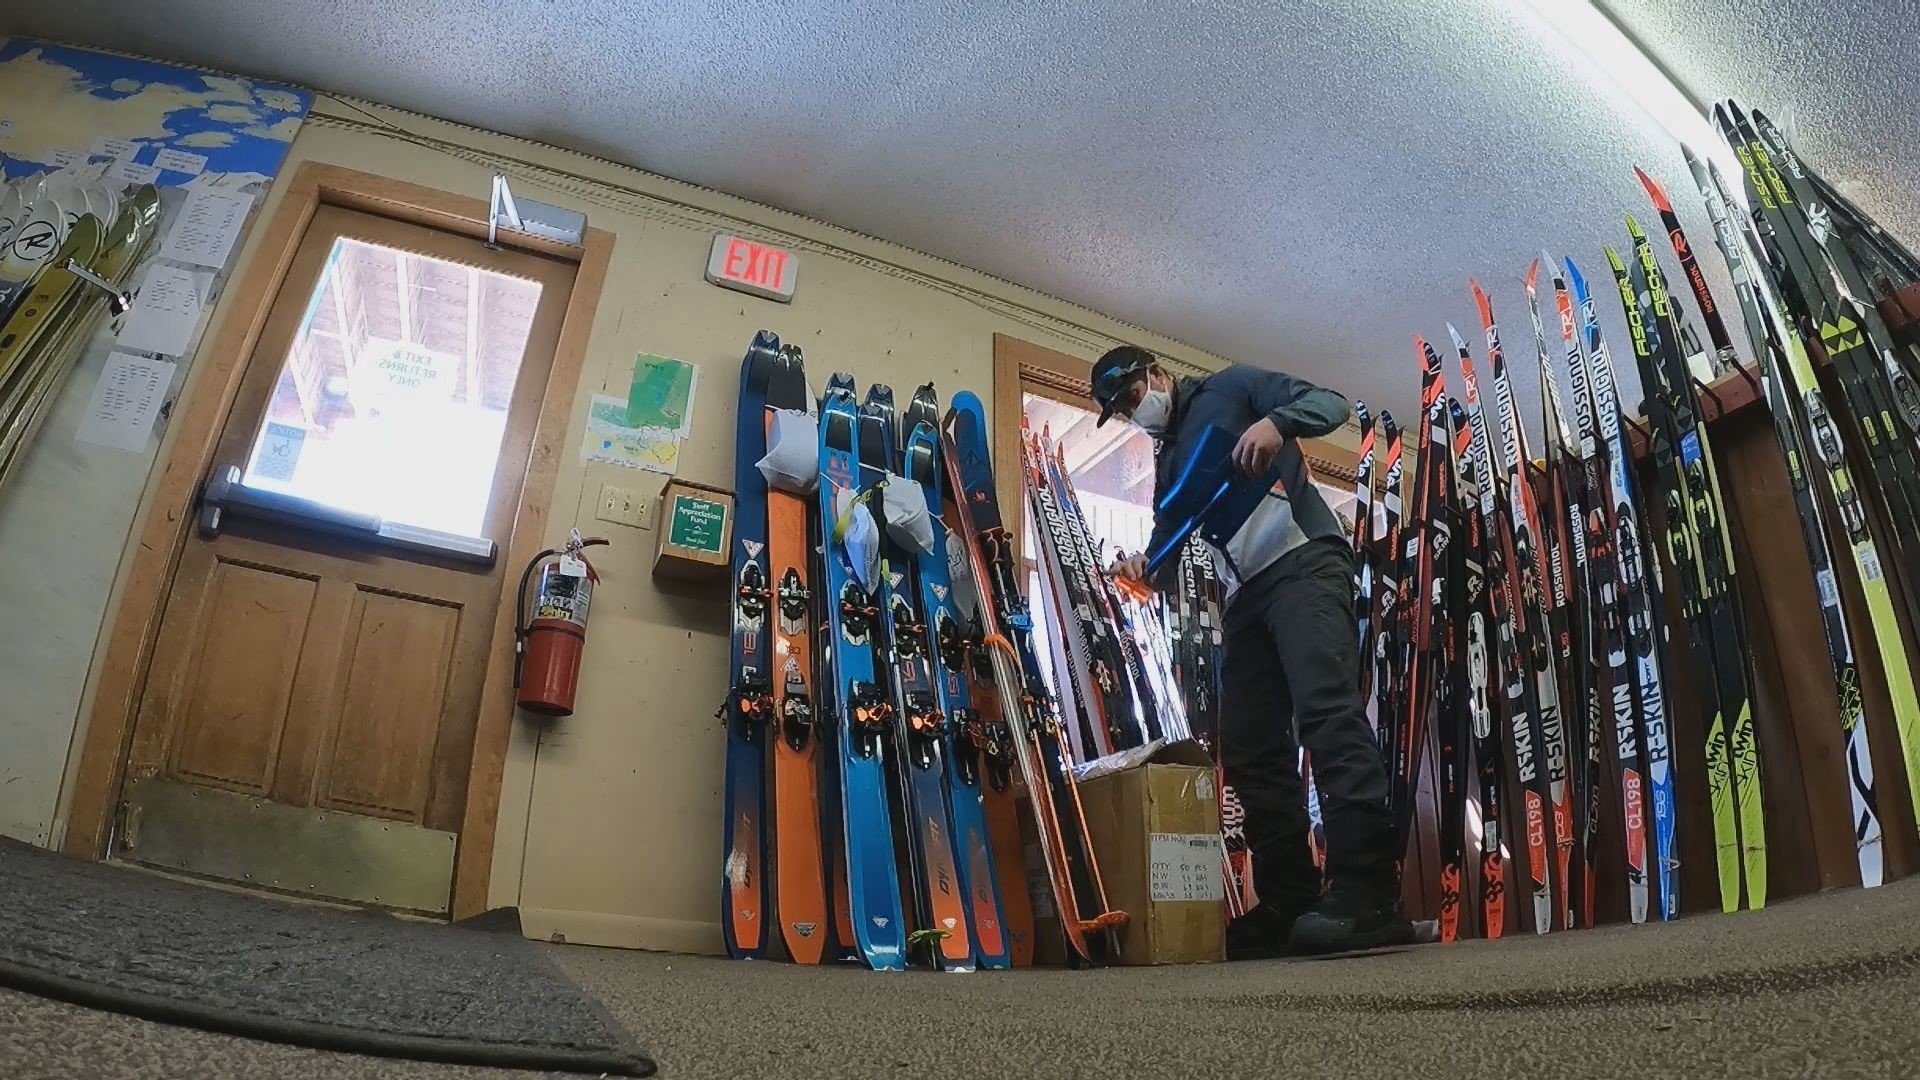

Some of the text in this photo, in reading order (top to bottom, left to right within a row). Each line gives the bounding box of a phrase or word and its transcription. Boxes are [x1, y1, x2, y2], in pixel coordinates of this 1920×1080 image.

[1735, 145, 1778, 208] FISCHER
[1751, 140, 1793, 204] FISCHER
[1766, 127, 1805, 178] FISCHER
[724, 238, 789, 290] EXIT
[1638, 242, 1668, 317] FISCHER
[1690, 263, 1714, 313] ROSSIGNOL
[1618, 276, 1650, 356] FISCHER
[1494, 370, 1518, 468] ROSSIGNOL
[1567, 342, 1592, 442] ROSSIGNOL
[1591, 343, 1620, 440] ROSSIGNOL
[1469, 406, 1491, 497] ROSSIGNOL
[678, 506, 722, 520] Appreciation
[690, 516, 708, 524] Fund
[692, 502, 710, 510] Staff
[1038, 484, 1075, 567] ROSSIGNOL
[1569, 503, 1587, 568] ROSSIGNOL
[1550, 543, 1566, 608] ROSSIGNOL
[1527, 798, 1544, 847] CL198
[1626, 778, 1642, 829] CL198
